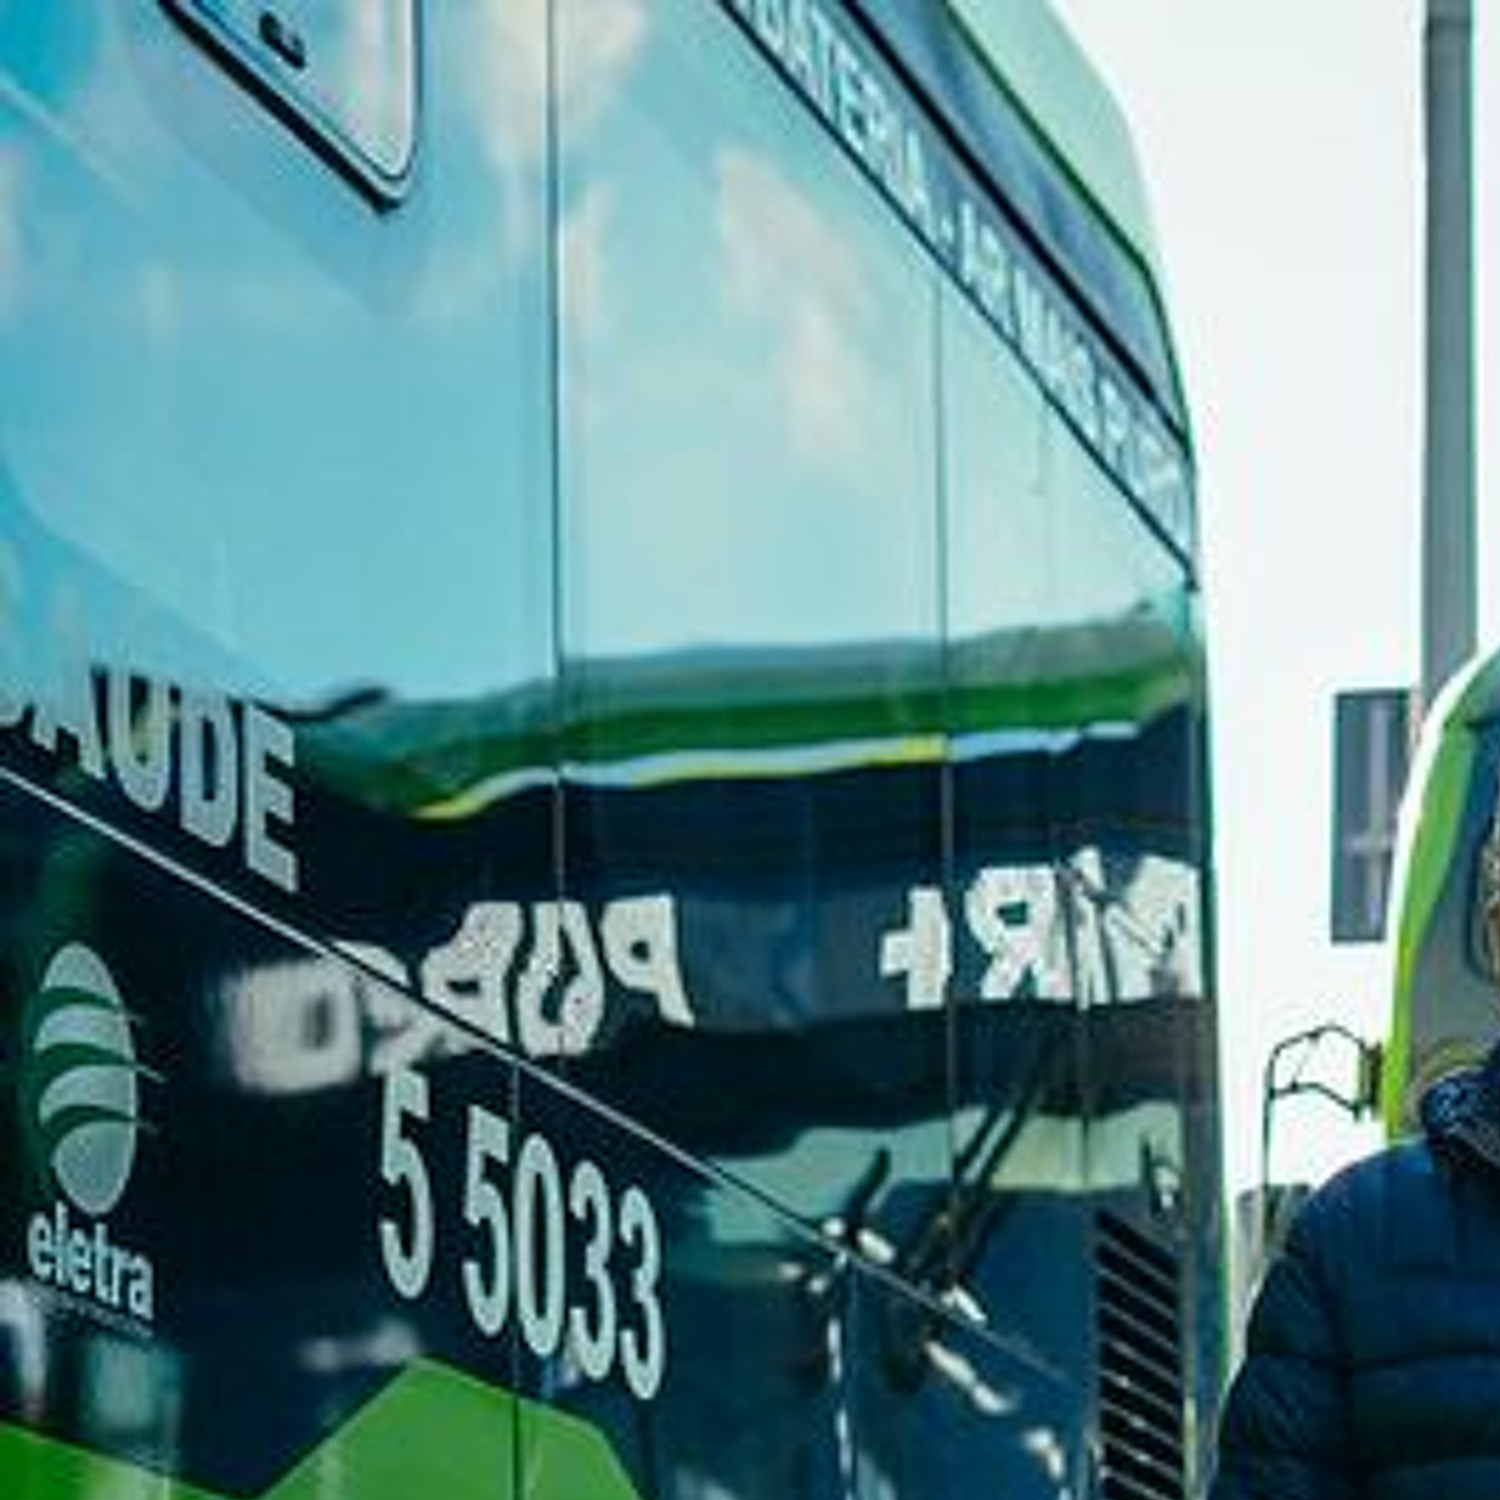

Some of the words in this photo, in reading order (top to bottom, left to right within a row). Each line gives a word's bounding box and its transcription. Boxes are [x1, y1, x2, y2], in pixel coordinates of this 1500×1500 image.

[28, 1201, 154, 1321] eletra
[379, 1062, 435, 1299] 5
[463, 1104, 665, 1400] 5033
